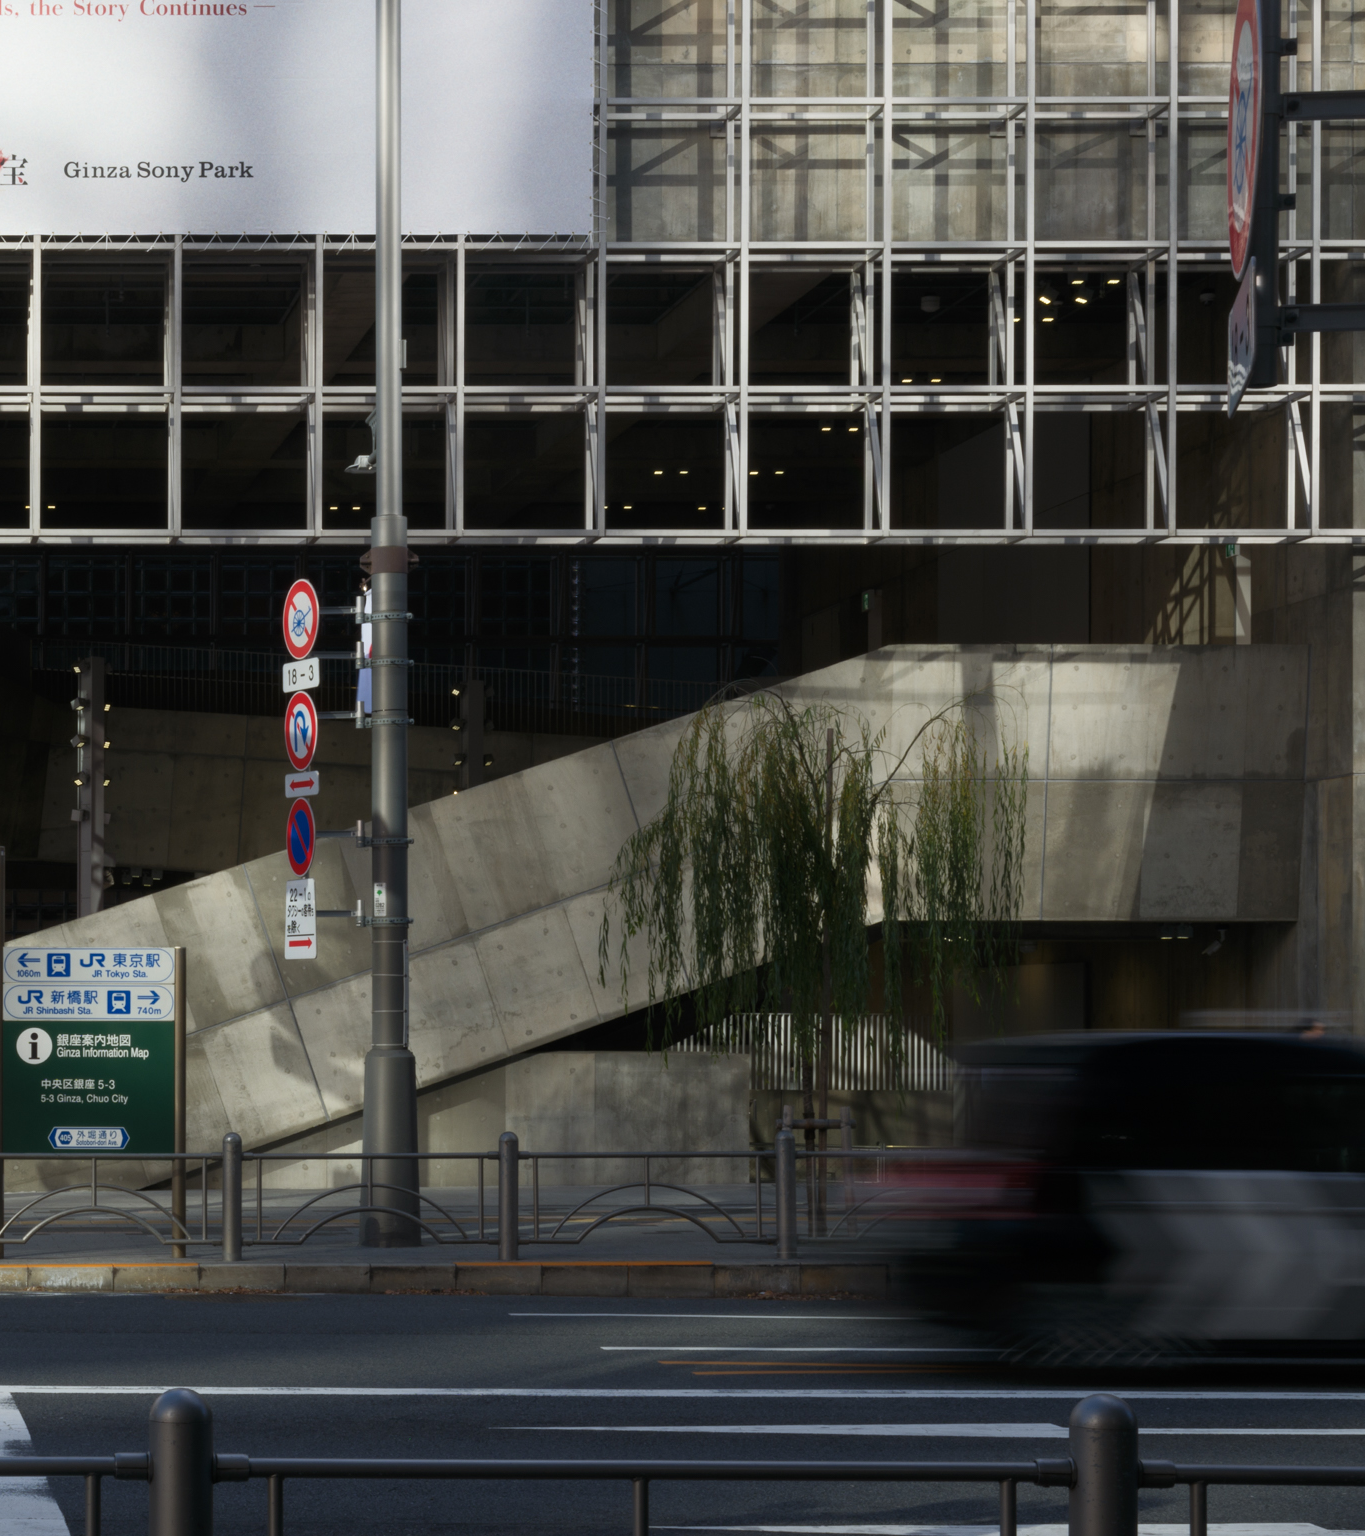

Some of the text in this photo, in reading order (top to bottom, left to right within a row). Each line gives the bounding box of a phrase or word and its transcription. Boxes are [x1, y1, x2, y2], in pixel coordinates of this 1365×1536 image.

[63, 160, 254, 183] Ginza Sony Park
[80, 953, 161, 968] JR 東京駅
[16, 970, 41, 978] 1060m
[92, 970, 148, 980] JR Tokyo Sta.
[18, 990, 99, 1005] JR 新橋駅
[23, 1007, 93, 1015] JR Shinbashi Sta.
[137, 1007, 162, 1015] 740m
[56, 1034, 131, 1047] 銀座案内地図
[56, 1047, 149, 1060] Ginza Information Map
[41, 1079, 116, 1090] 中央区銀座 5-3
[40, 1094, 129, 1105] 5-3 Ginza, Chuo City
[59, 1133, 71, 1142] 405
[76, 1130, 118, 1140] 外堀通り
